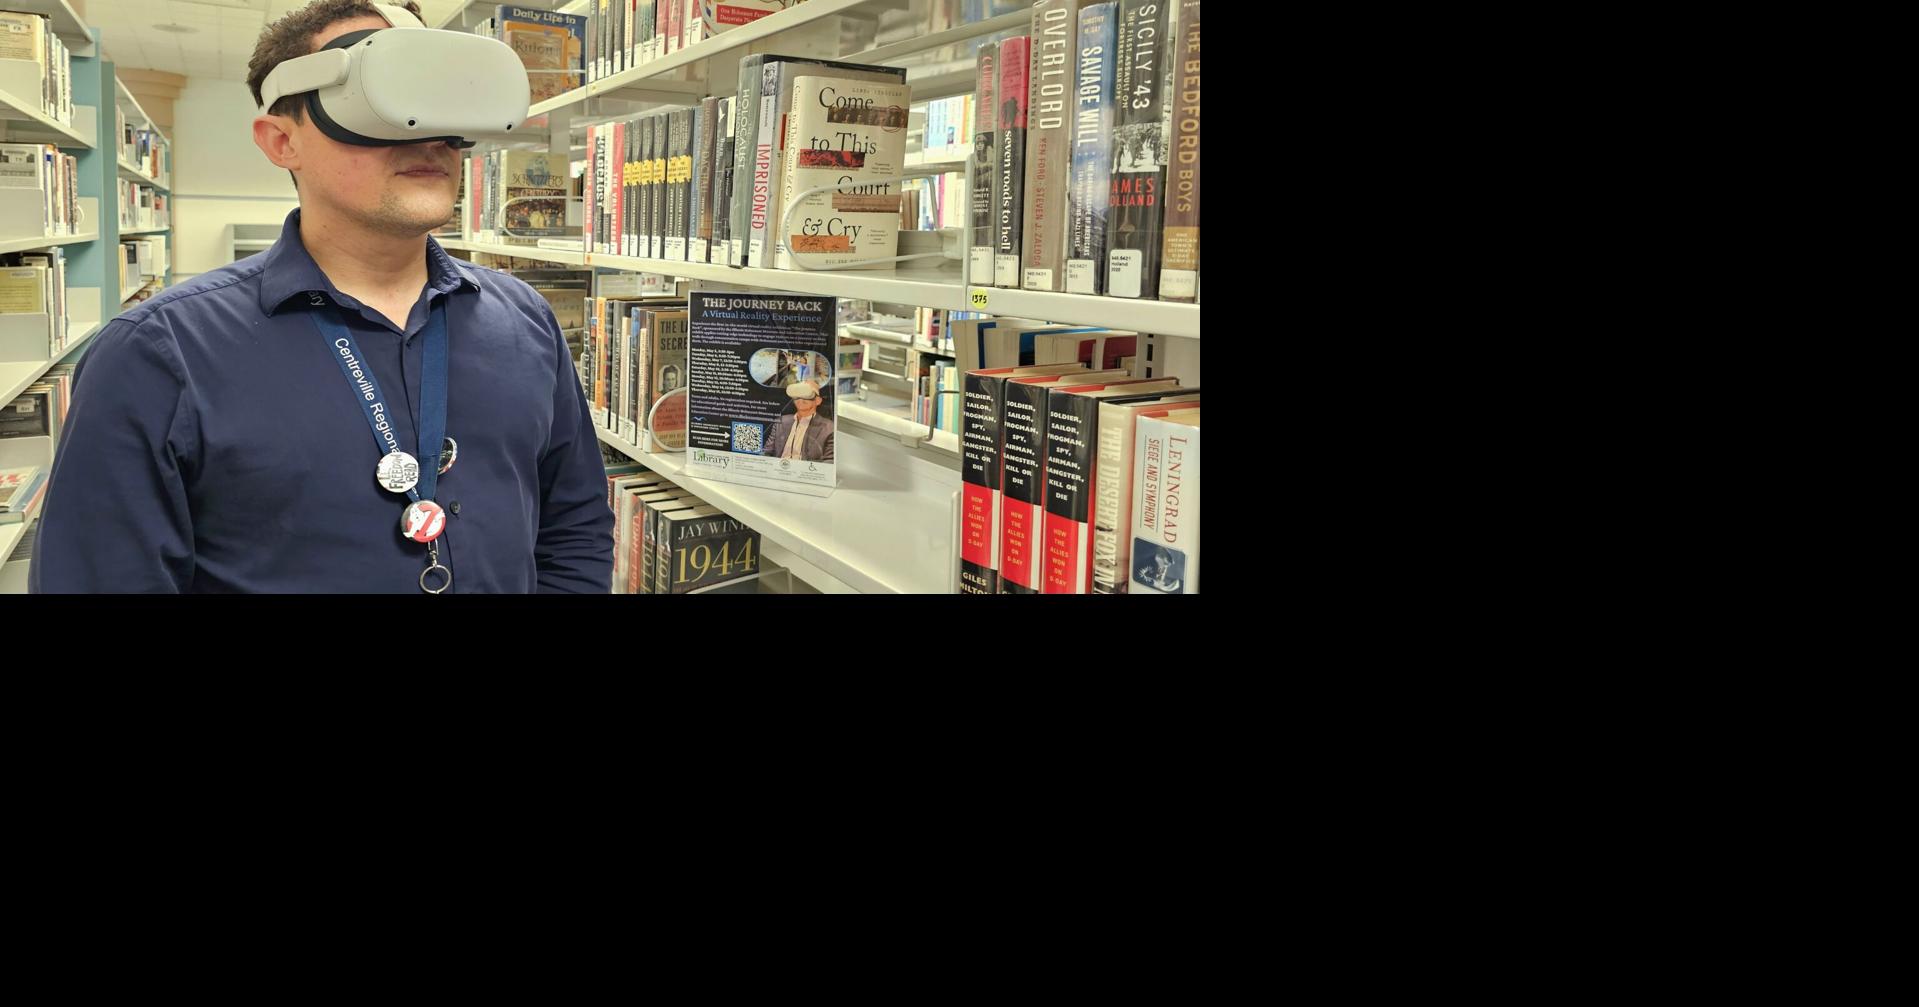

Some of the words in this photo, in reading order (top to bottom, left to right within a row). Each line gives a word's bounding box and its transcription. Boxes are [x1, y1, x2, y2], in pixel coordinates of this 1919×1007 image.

[513, 8, 541, 21] Daily
[1128, 10, 1136, 27] THE
[1125, 30, 1134, 52] FIRST
[1135, 4, 1157, 71] SICILY
[1039, 8, 1068, 130] OVERLORD
[1079, 46, 1103, 105] SAVAGE
[1123, 55, 1132, 92] ASSAULT
[818, 86, 874, 110] Come
[1121, 95, 1129, 109] ON
[1178, 60, 1200, 164] BEDFORD
[736, 88, 751, 170] HOLOCAUST
[1077, 108, 1100, 148] WILL
[811, 135, 830, 151] to
[836, 132, 877, 155] This
[1003, 130, 1012, 168] seven
[1036, 158, 1046, 180] FORD
[751, 144, 772, 229] IMPRISONED
[837, 175, 891, 195] Court
[1002, 170, 1013, 207] roads
[1177, 170, 1194, 213] BOYS
[1035, 187, 1046, 220] STEVEN
[1107, 193, 1155, 208] OLLAND
[1001, 209, 1011, 224] to
[827, 217, 862, 244] Cry
[1001, 226, 1011, 251] hell
[702, 297, 726, 308] THE
[727, 298, 784, 311] JOURNEY
[787, 301, 823, 312] BACK
[971, 294, 988, 304] 1375
[702, 310, 709, 318] A
[709, 310, 739, 319] Virtual
[740, 311, 770, 321] Reality
[772, 314, 822, 323] Experience
[661, 320, 677, 334] THE
[660, 336, 688, 351] SECRE
[334, 337, 376, 401] Centreville
[369, 402, 400, 453] Regiona
[965, 391, 994, 402] SOLDIER,
[966, 402, 992, 412] SAILOR,
[1006, 400, 1036, 412] SOLDIER,
[1007, 411, 1034, 422] SAILOR,
[1050, 410, 1082, 424] SOLDIER,
[971, 423, 986, 431] SPY,
[1051, 422, 1080, 435] SAILOR,
[964, 431, 994, 443] AIRMAN,
[1012, 434, 1027, 443] SPY,
[1005, 443, 1035, 456] AIRMAN,
[1056, 446, 1072, 457] SPY,
[1147, 439, 1160, 463] SIEGE
[693, 450, 730, 469] Library
[965, 452, 980, 460] KILL
[981, 455, 991, 463] OR
[1048, 455, 1081, 470] AIRMAN,
[972, 463, 984, 471] DIE
[1005, 464, 1020, 473] KILL
[1146, 464, 1158, 480] AND
[1012, 477, 1024, 485] DIE
[1048, 478, 1064, 489] KILL
[1066, 483, 1077, 492] OR
[1055, 492, 1068, 501] DIE
[1163, 436, 1188, 544] LENINGRAD
[1143, 483, 1157, 530] SYMPHONY
[678, 523, 706, 541] JAY
[708, 518, 750, 535] WINI
[1011, 520, 1021, 528] THE
[1054, 538, 1065, 547] THE
[1096, 531, 1118, 566] FOX
[674, 537, 756, 584] 1944
[962, 572, 987, 586] GILES
